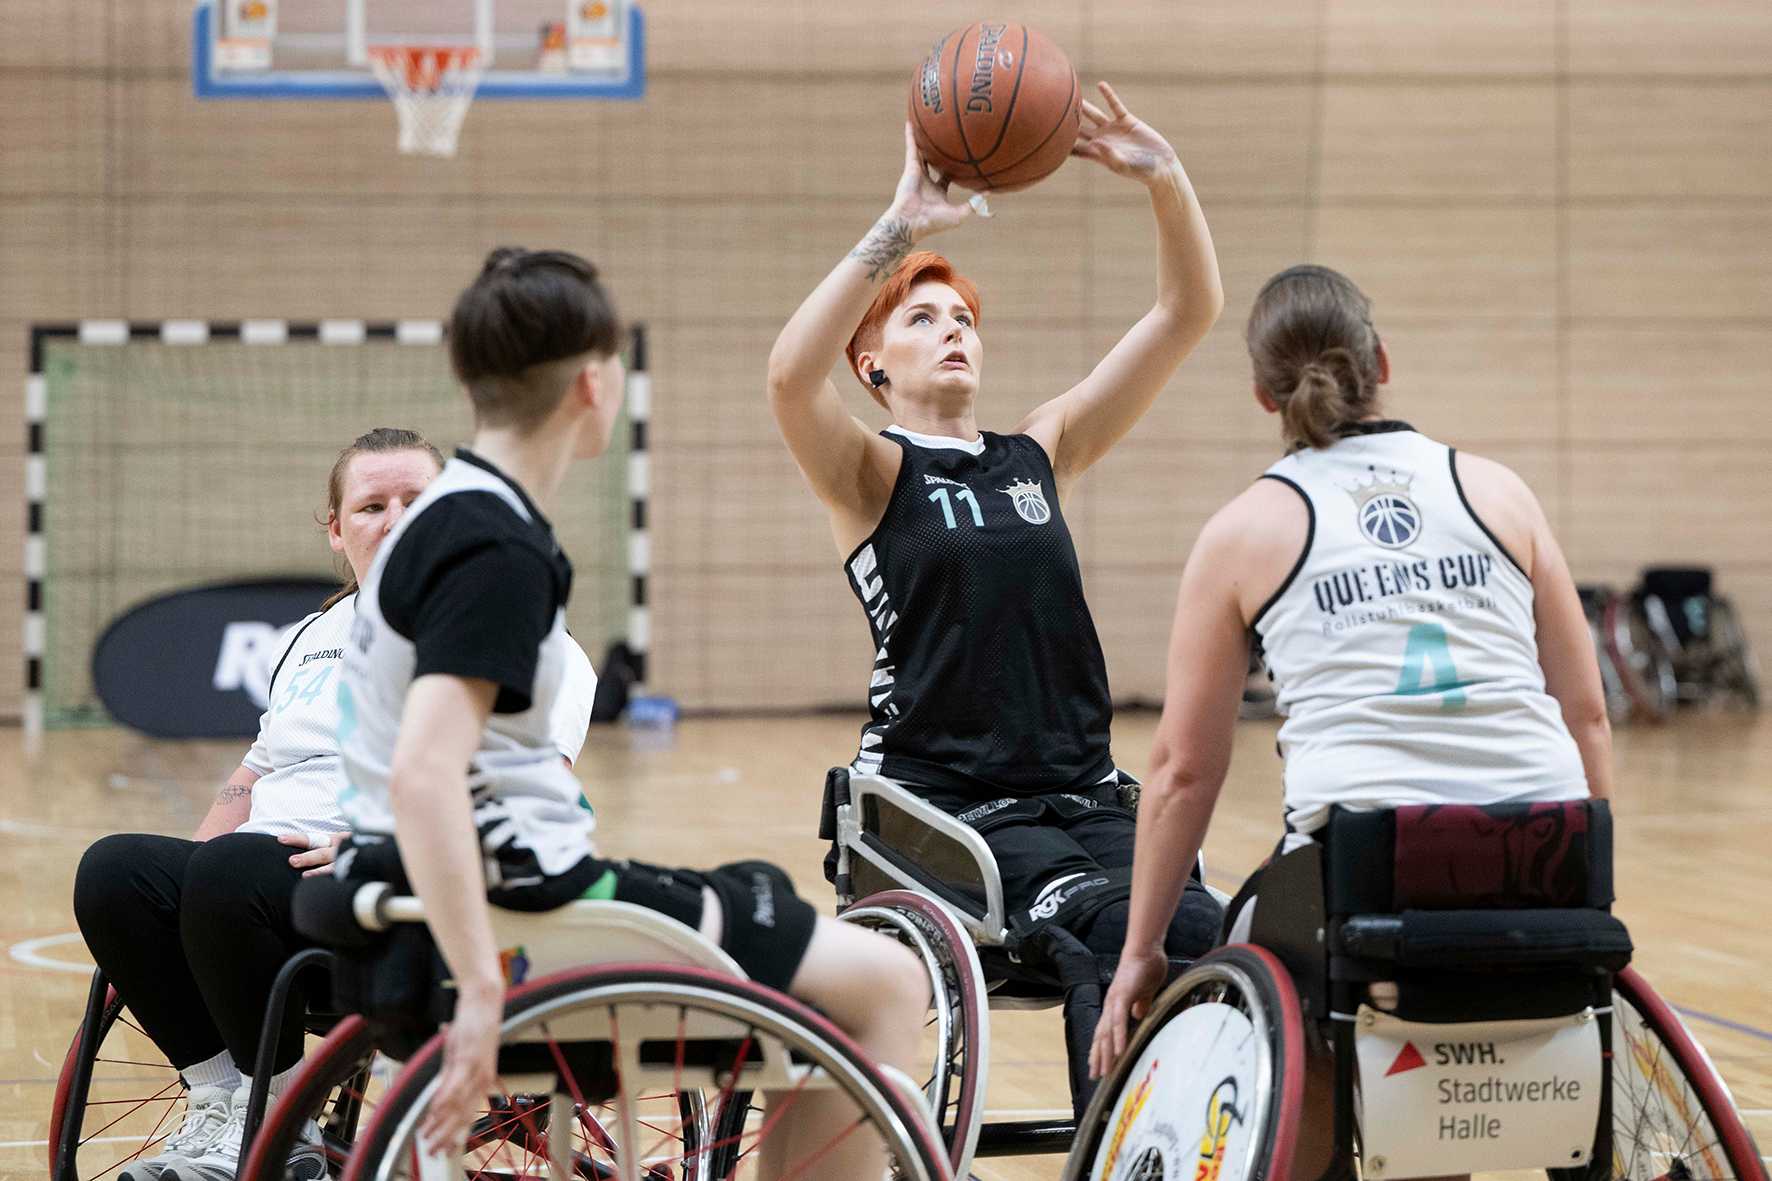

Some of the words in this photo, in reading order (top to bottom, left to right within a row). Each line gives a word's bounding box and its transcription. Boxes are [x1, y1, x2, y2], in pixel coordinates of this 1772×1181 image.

[928, 487, 985, 529] 11
[1313, 560, 1431, 615] QUEENS
[1439, 553, 1492, 590] CUP
[276, 665, 335, 714] 54
[1434, 1042, 1504, 1066] SWH.
[1438, 1075, 1581, 1104] Stadtwerke
[1439, 1113, 1501, 1140] Halle
